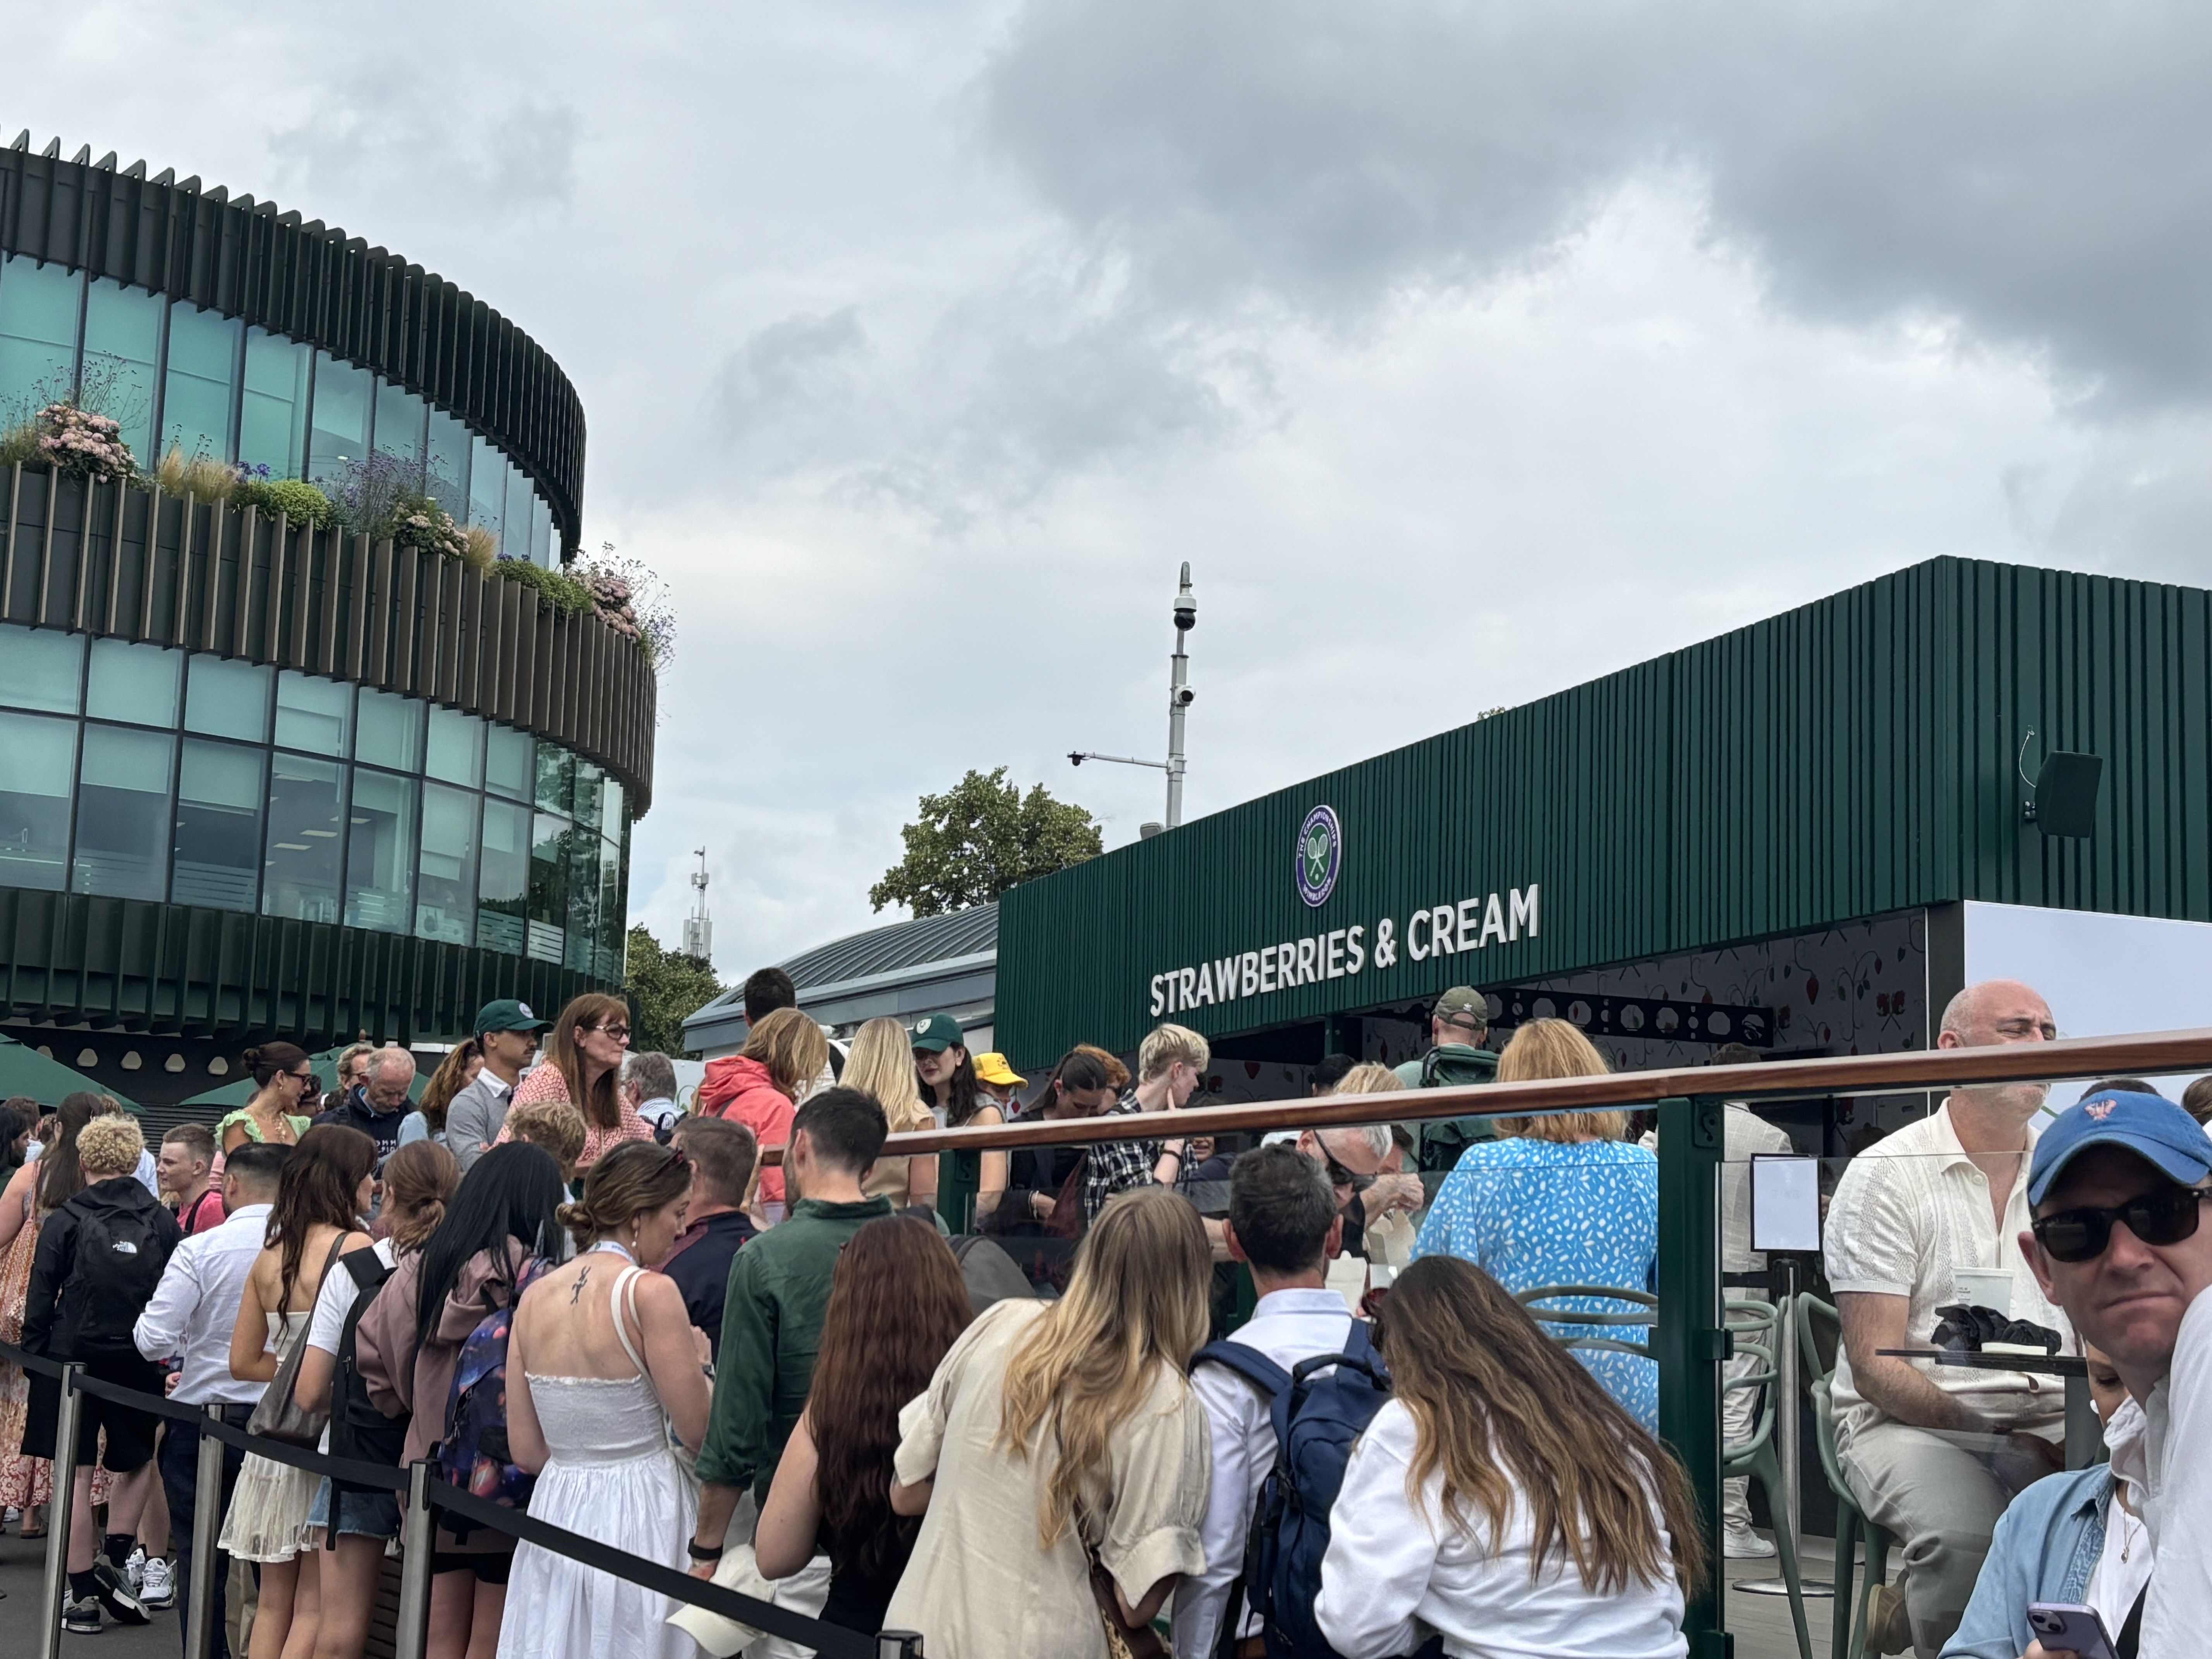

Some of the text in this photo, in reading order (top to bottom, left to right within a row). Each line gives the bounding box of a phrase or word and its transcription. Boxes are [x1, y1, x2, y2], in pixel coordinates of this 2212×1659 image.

[1304, 811, 1337, 847] CHAMPIONSHIPS
[1304, 877, 1331, 901] WIMBLEDON
[1150, 884, 1538, 1017] STRAWBERRIES & CREAM
